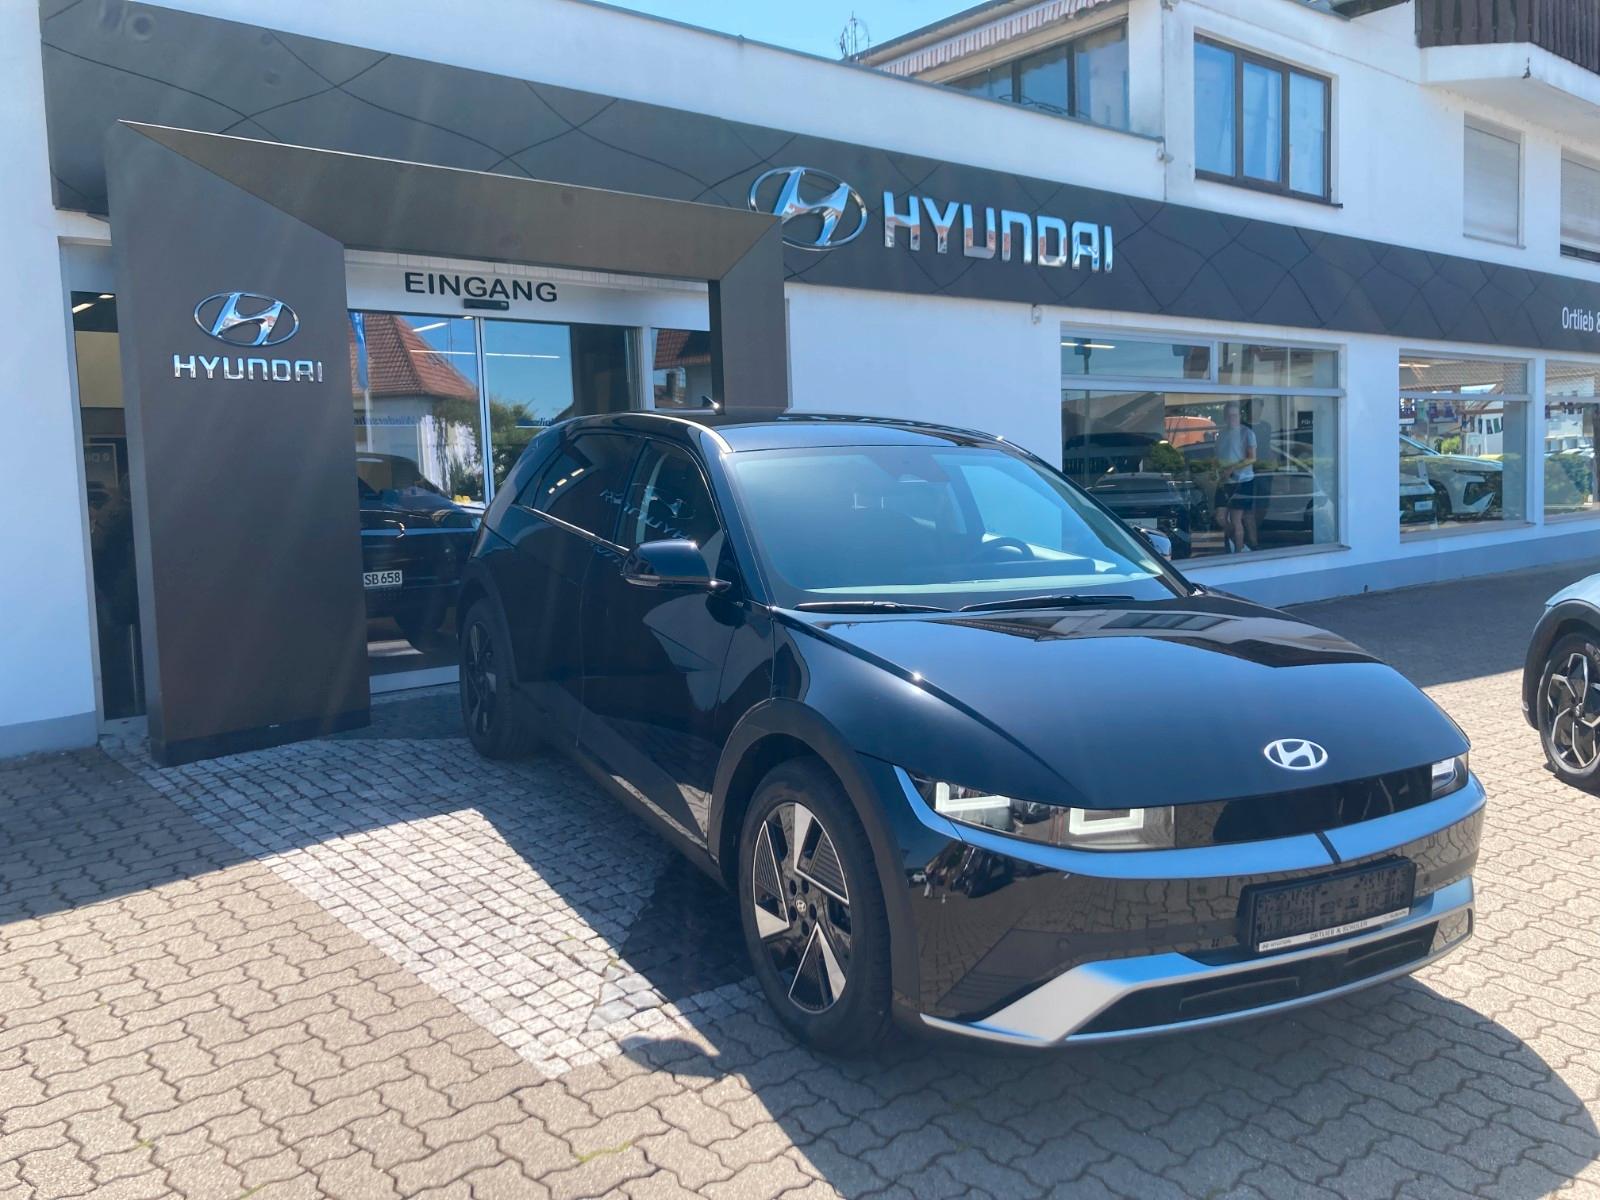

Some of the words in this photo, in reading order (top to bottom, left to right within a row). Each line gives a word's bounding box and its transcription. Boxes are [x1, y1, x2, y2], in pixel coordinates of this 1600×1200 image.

[883, 191, 1114, 273] HYUNDAI
[404, 271, 558, 303] EINGANG
[1562, 306, 1594, 332] Ortlieb
[173, 354, 323, 383] HYUNDAI
[380, 571, 401, 584] 658
